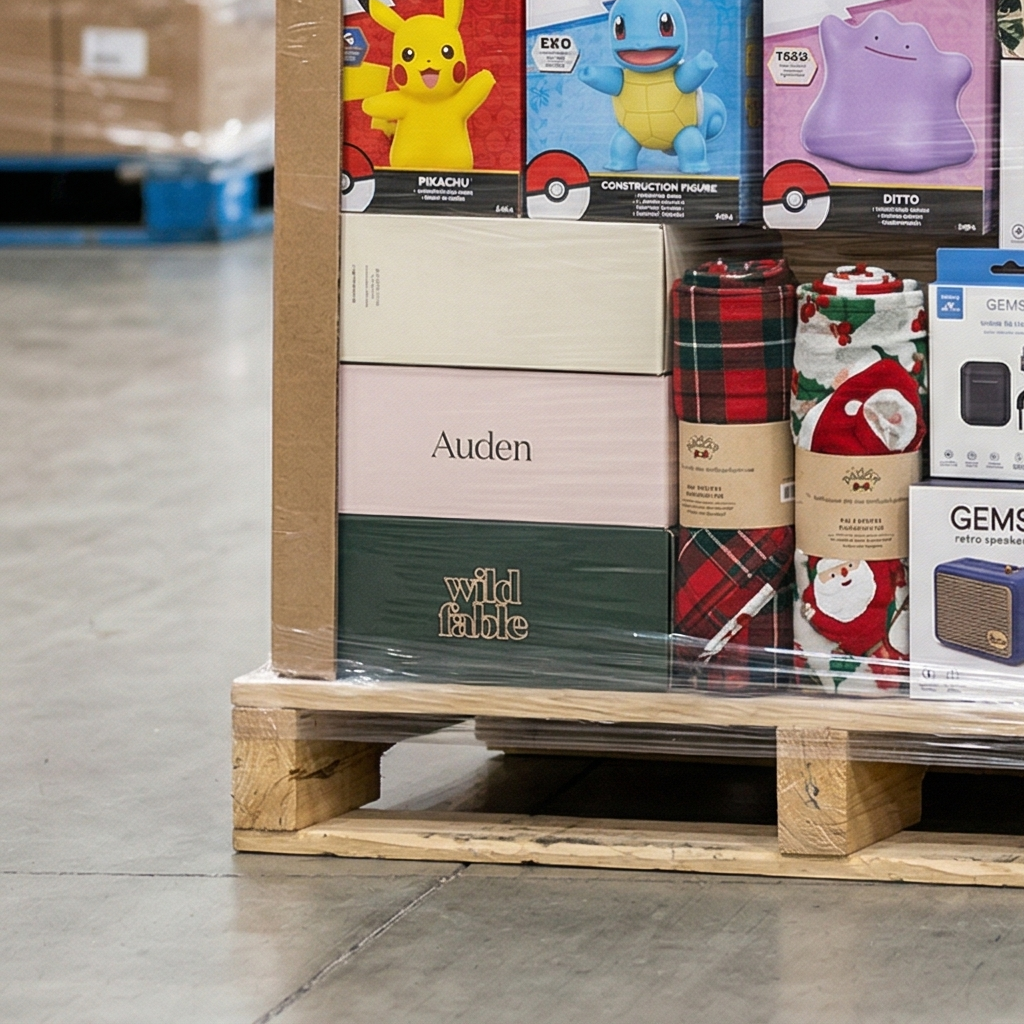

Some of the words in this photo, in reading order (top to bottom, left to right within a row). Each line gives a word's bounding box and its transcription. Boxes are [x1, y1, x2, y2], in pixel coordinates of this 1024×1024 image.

[418, 176, 470, 188] PIKACHU
[600, 180, 679, 193] CONSTRUCTION
[883, 193, 920, 205] DITTO
[431, 430, 532, 462] Auden
[955, 535, 982, 545] retro
[443, 566, 522, 606] wild
[438, 602, 529, 641] fable
